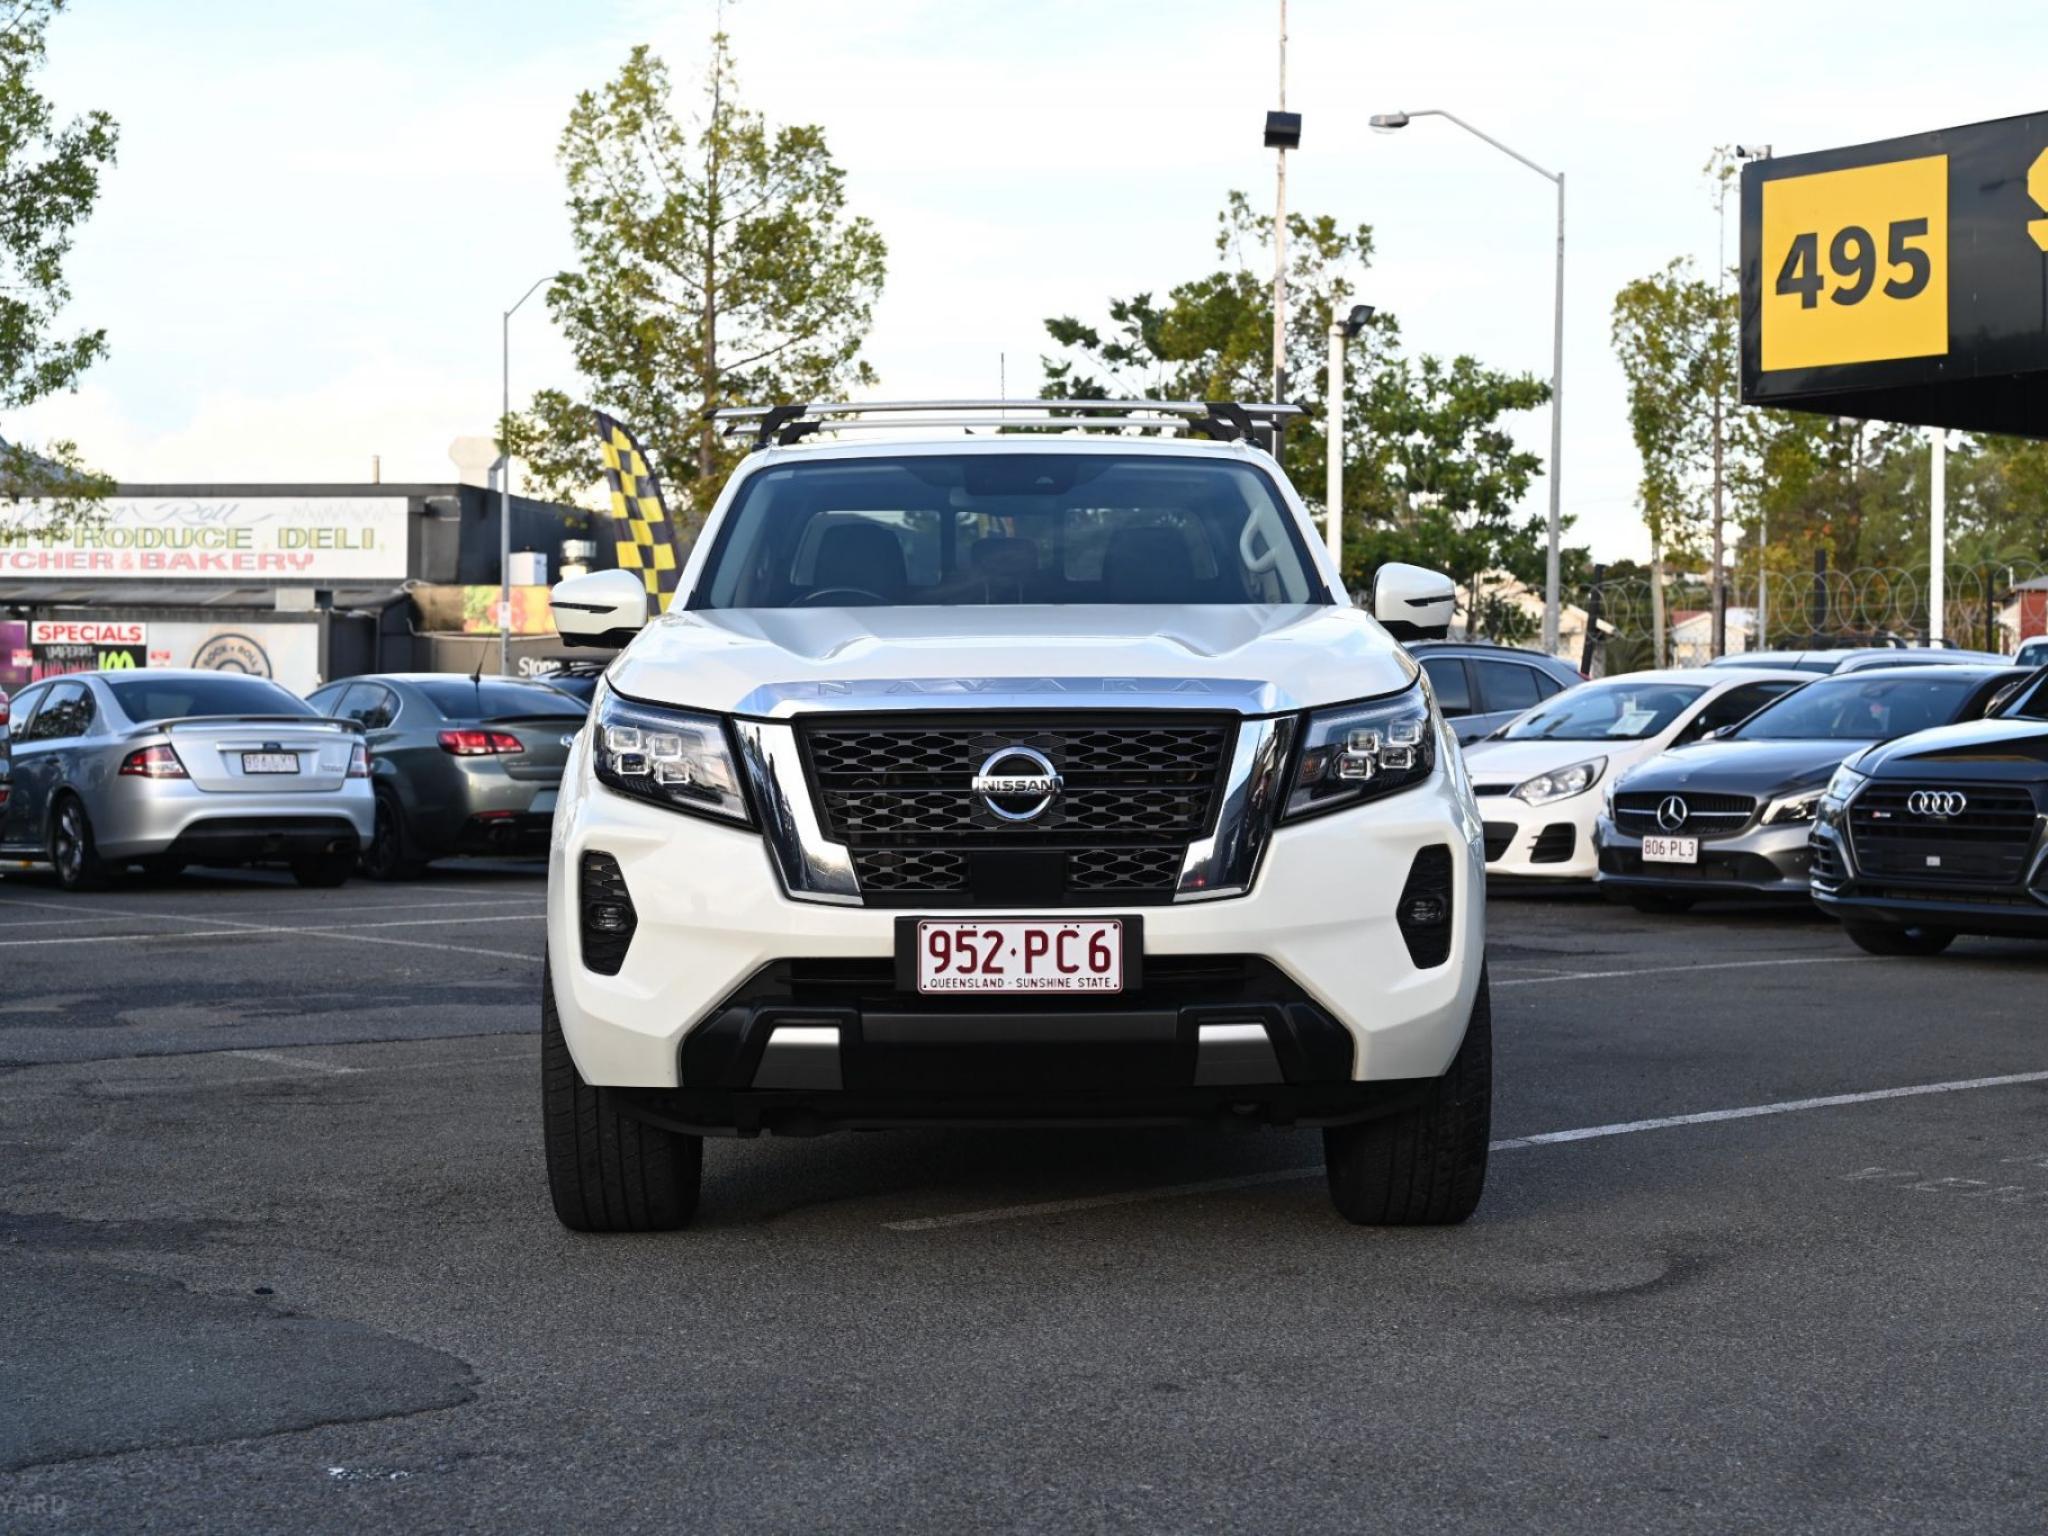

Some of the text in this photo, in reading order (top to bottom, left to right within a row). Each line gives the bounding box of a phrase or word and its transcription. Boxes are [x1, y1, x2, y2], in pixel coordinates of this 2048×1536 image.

[1776, 217, 1931, 310] 495
[140, 552, 314, 571] BAKERY
[37, 624, 142, 642] SPECIALS
[818, 678, 1213, 695] NAVARA
[983, 779, 1054, 792] NISSAN
[930, 977, 1005, 989] QUEENSLAND
[1016, 977, 1072, 989] SUNSHINE
[1078, 977, 1111, 989] STATE
